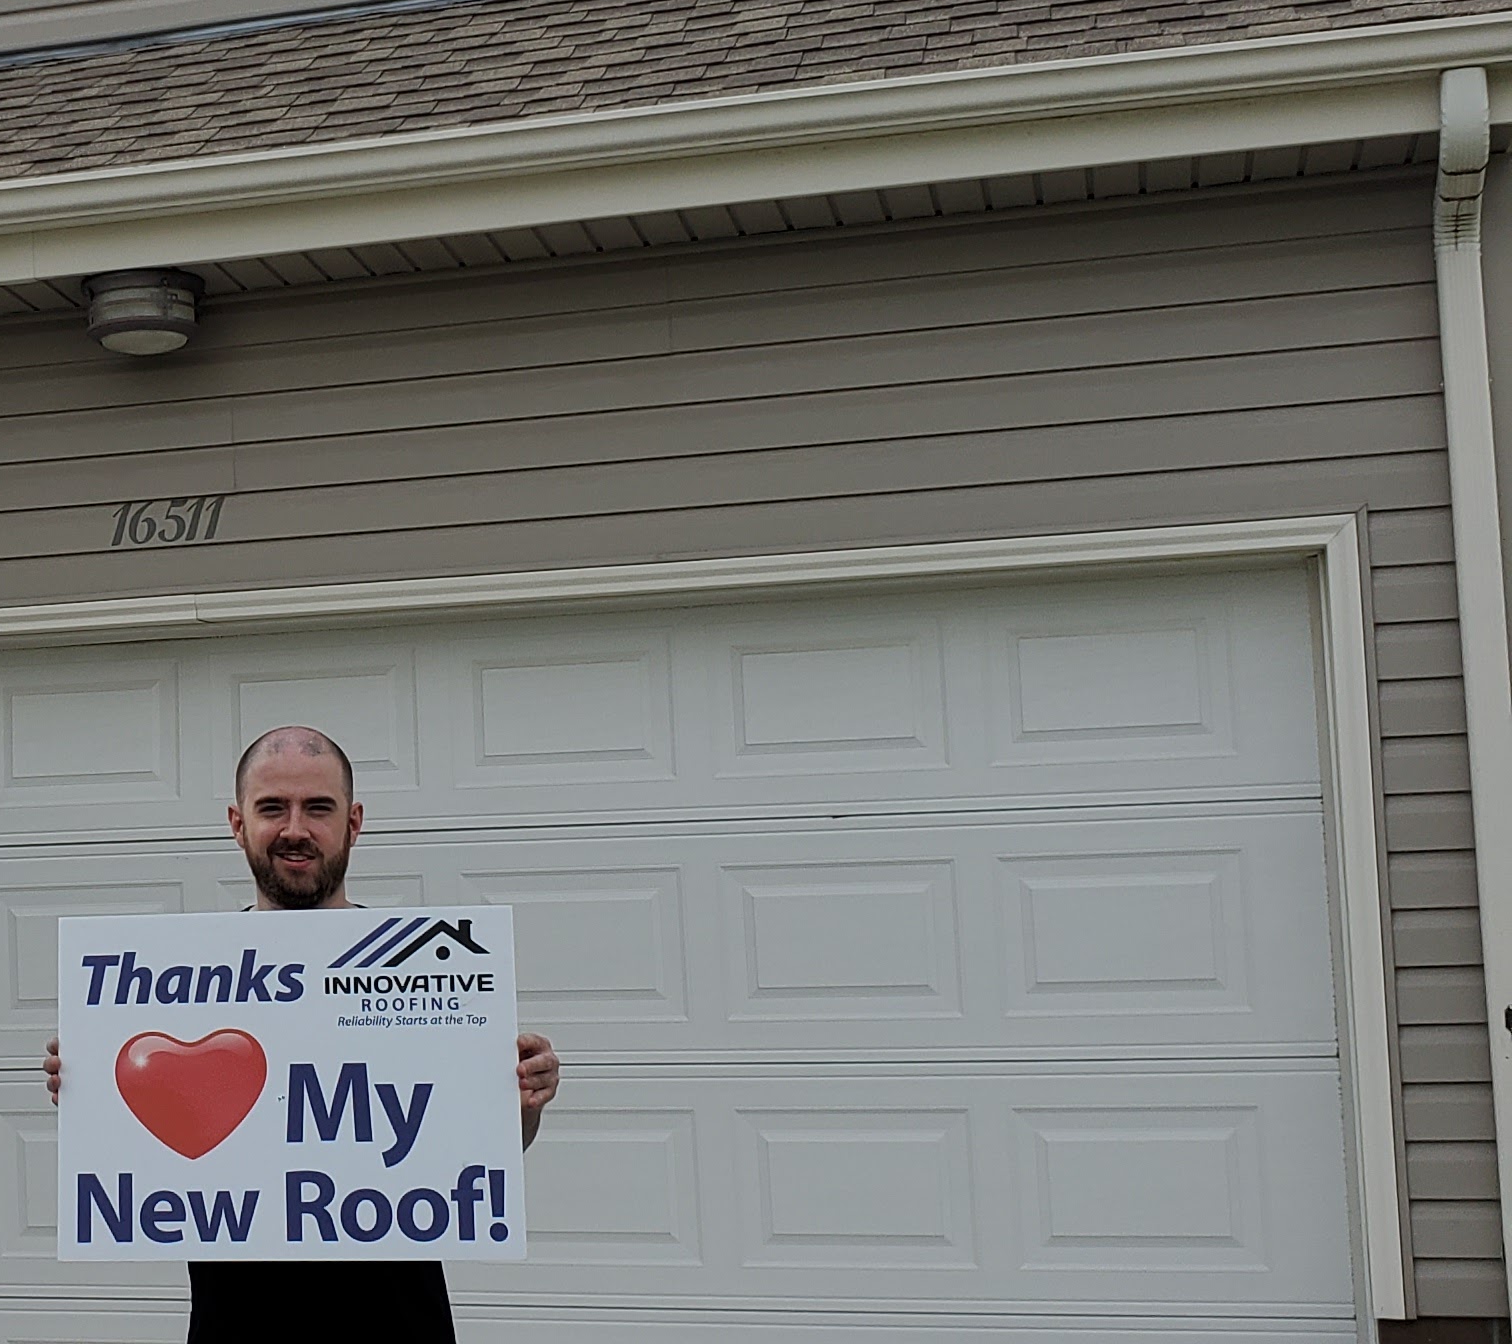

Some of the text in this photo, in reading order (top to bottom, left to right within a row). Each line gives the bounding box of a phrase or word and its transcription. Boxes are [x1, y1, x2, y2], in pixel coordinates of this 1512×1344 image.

[111, 496, 226, 547] 16511
[81, 948, 306, 1006] Thanks
[324, 973, 495, 995] INNOVATIVE
[337, 1014, 487, 1029] Reliability Starts at the Top
[361, 996, 460, 1013] ROOFING
[286, 1062, 434, 1169] My
[77, 1161, 509, 1244] New Roof!
